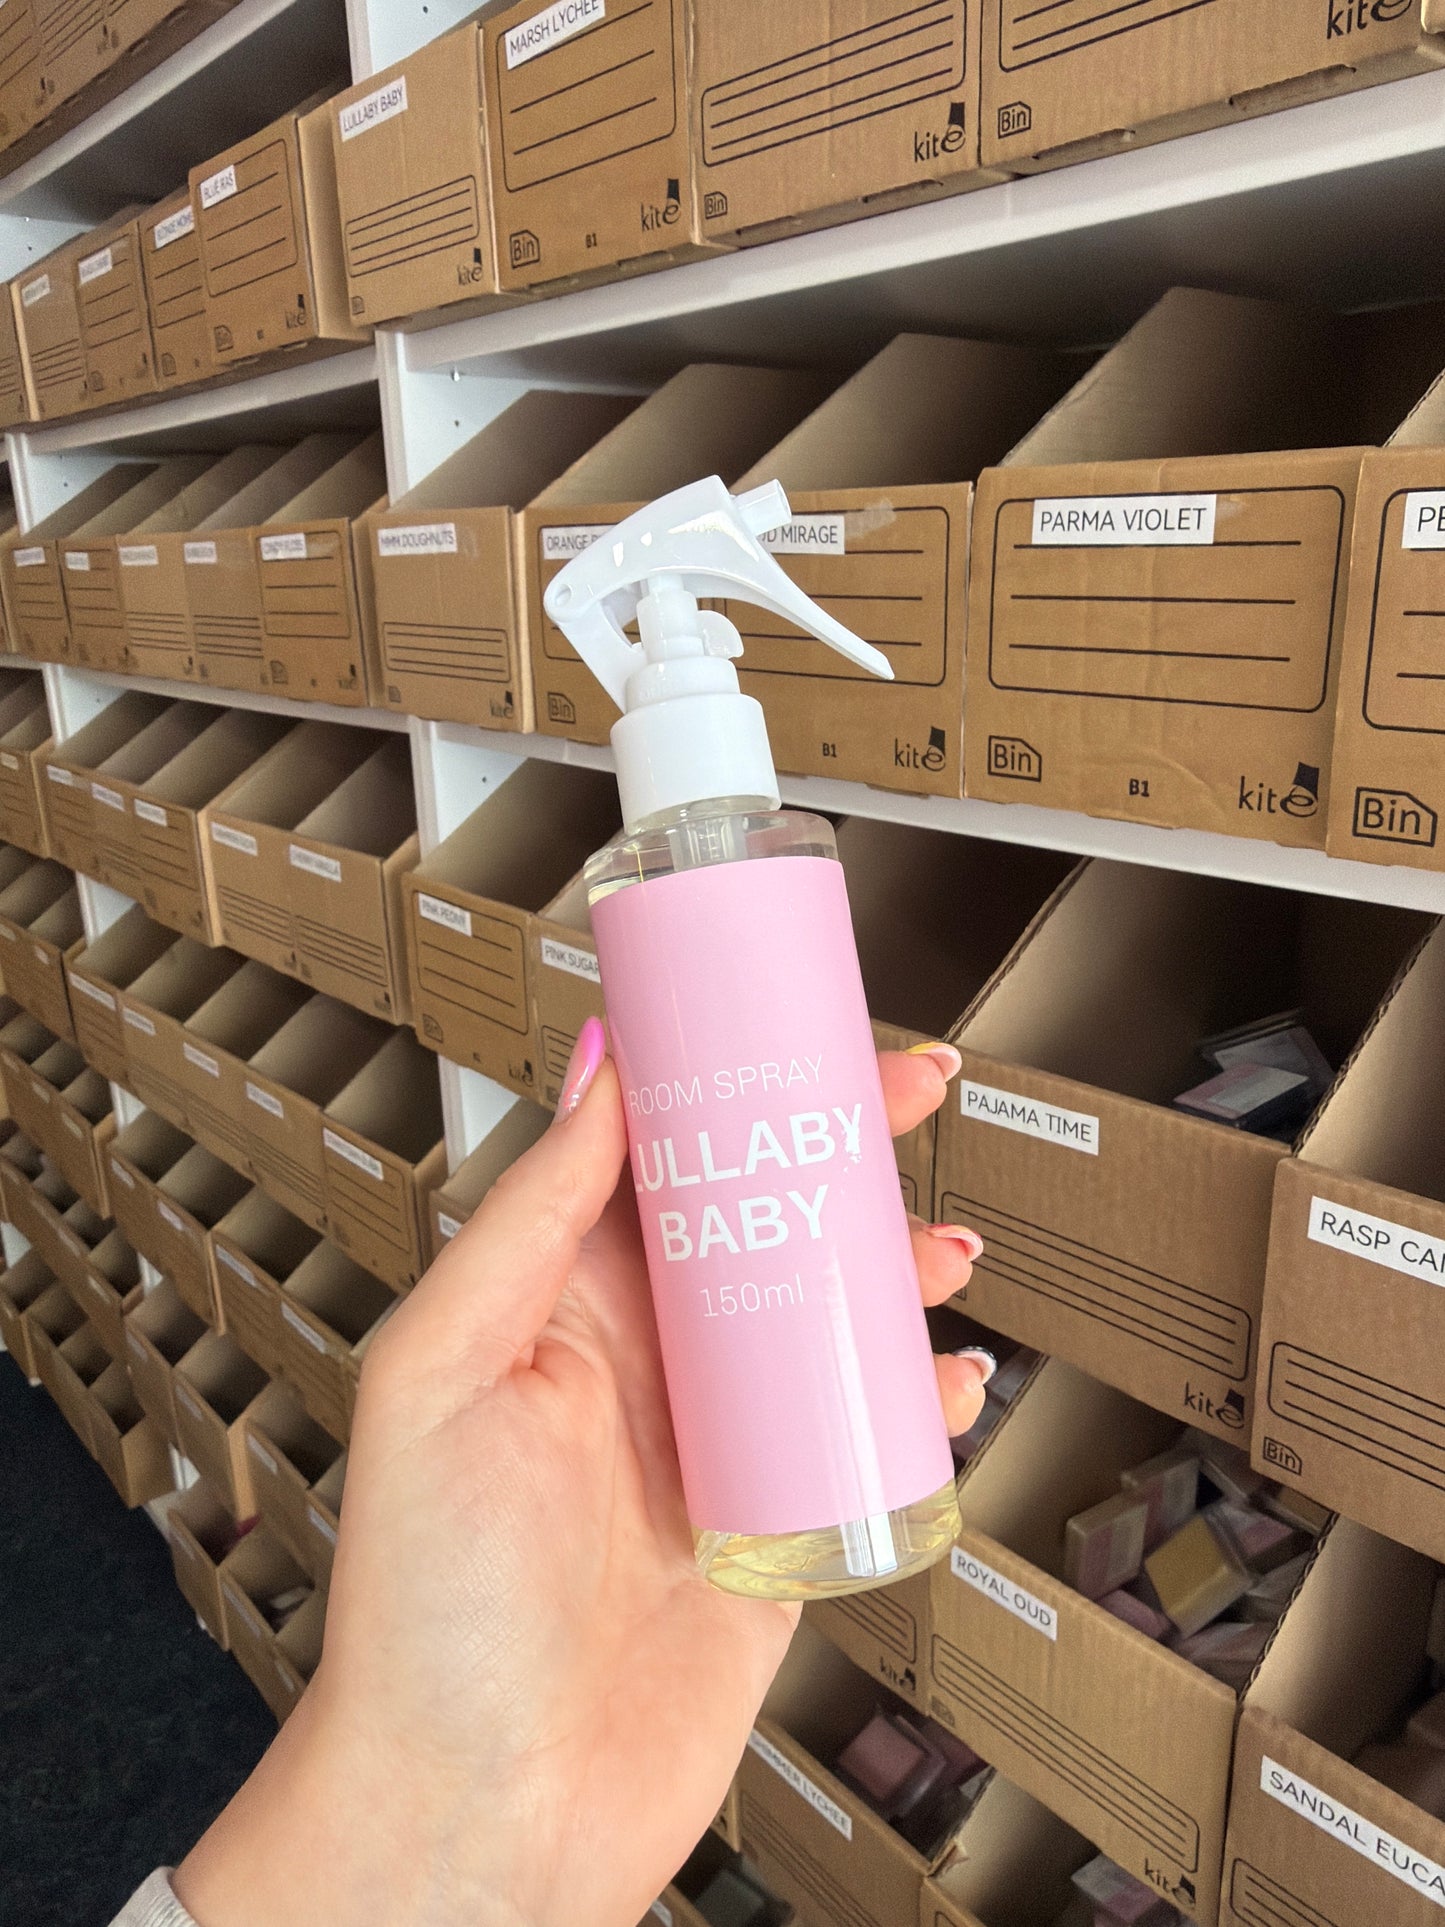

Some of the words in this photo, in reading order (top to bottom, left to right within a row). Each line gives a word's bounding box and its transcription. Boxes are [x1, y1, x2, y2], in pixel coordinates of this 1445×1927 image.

[510, 18, 550, 57] MARSH
[552, 0, 599, 33] LYCHEE
[343, 100, 379, 133] LULLABY
[380, 84, 404, 113] BABY
[1001, 109, 1027, 132] Bin
[914, 123, 966, 163] kite
[641, 197, 681, 232] kite
[706, 197, 725, 215] Bin
[514, 237, 535, 261] Bin
[781, 525, 838, 543] MIRAGE
[1041, 510, 1115, 531] PARMA
[1123, 507, 1207, 531] VIOLET
[547, 534, 588, 551] ORANGE
[551, 697, 571, 718] Bin
[822, 742, 837, 758] B1
[894, 735, 946, 772] kite
[994, 743, 1032, 772] Bin
[1129, 778, 1150, 797] B1
[1238, 773, 1319, 818] kite
[1363, 797, 1420, 834] Bin
[629, 1075, 703, 1118] ROOM
[713, 1054, 823, 1100] SPRAY
[967, 1090, 1040, 1127] PAJAMA
[1045, 1112, 1091, 1142] TIME
[636, 1103, 862, 1193] ULLABY
[658, 1183, 829, 1262] BABY
[1321, 1211, 1391, 1250] RASP
[1400, 1240, 1445, 1273] CA
[700, 1273, 804, 1317] 150ml
[1184, 1381, 1245, 1429] kite
[1266, 1442, 1296, 1469] Bin
[957, 1555, 1009, 1601] ROYAL
[1014, 1593, 1051, 1626] OUD
[1269, 1770, 1367, 1846] SANDAL
[1376, 1838, 1445, 1897] EUCA
[1144, 1857, 1197, 1910] kite
